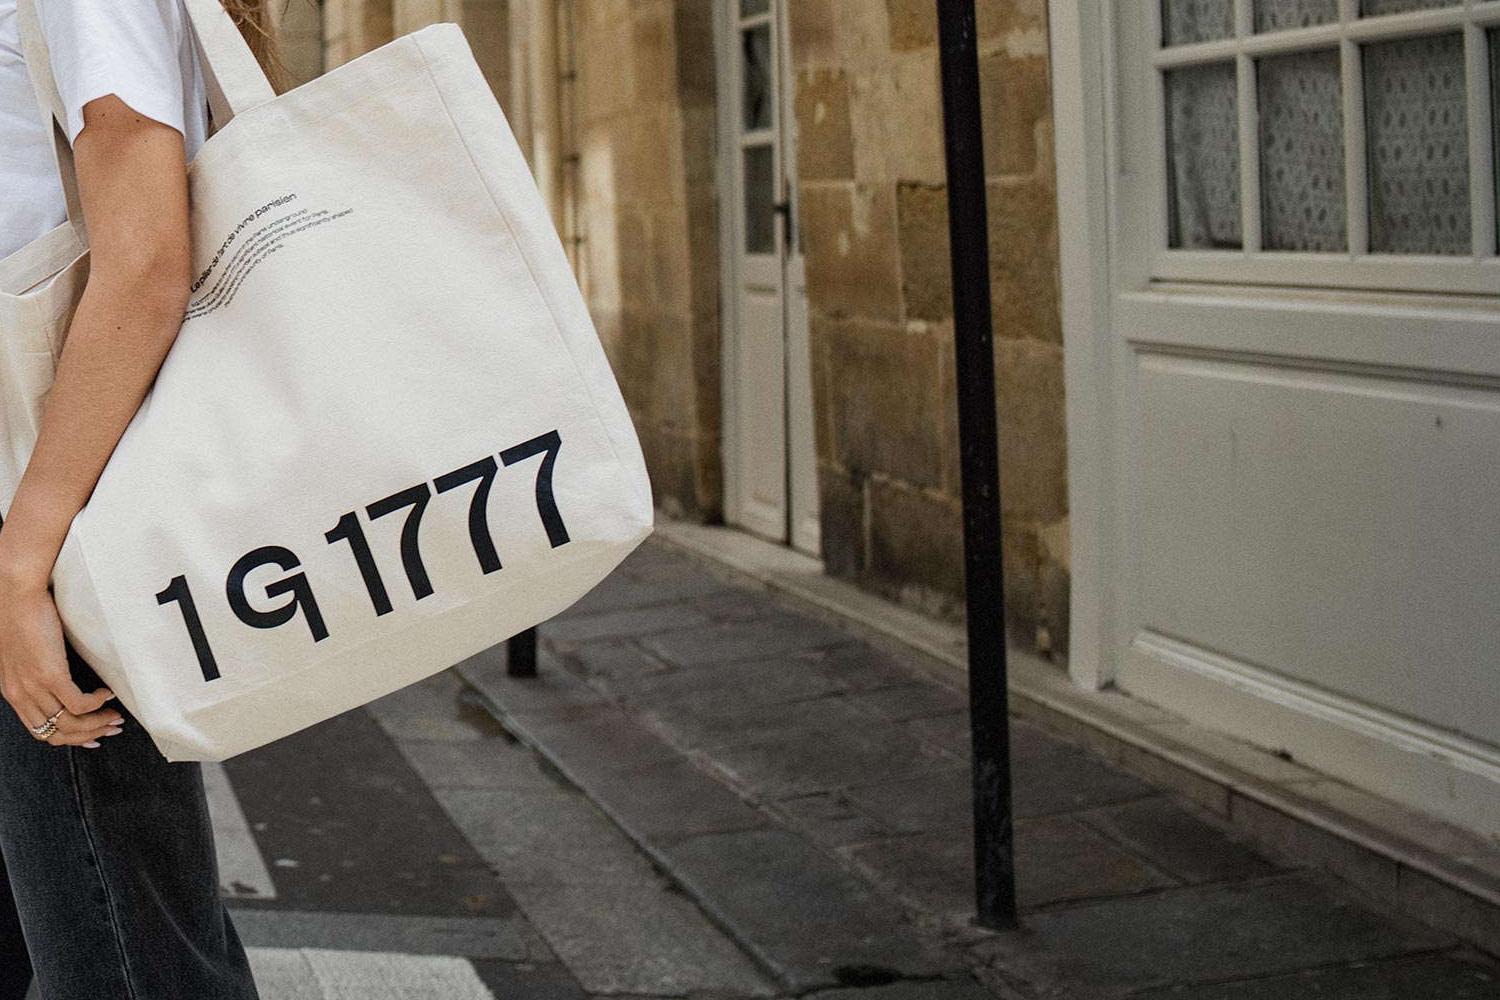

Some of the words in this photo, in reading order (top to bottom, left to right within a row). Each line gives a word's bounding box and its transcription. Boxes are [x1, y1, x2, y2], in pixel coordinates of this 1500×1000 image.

[190, 281, 201, 294] Le
[234, 214, 255, 234] vivre
[254, 193, 297, 219] parisien
[324, 430, 571, 617] 1777
